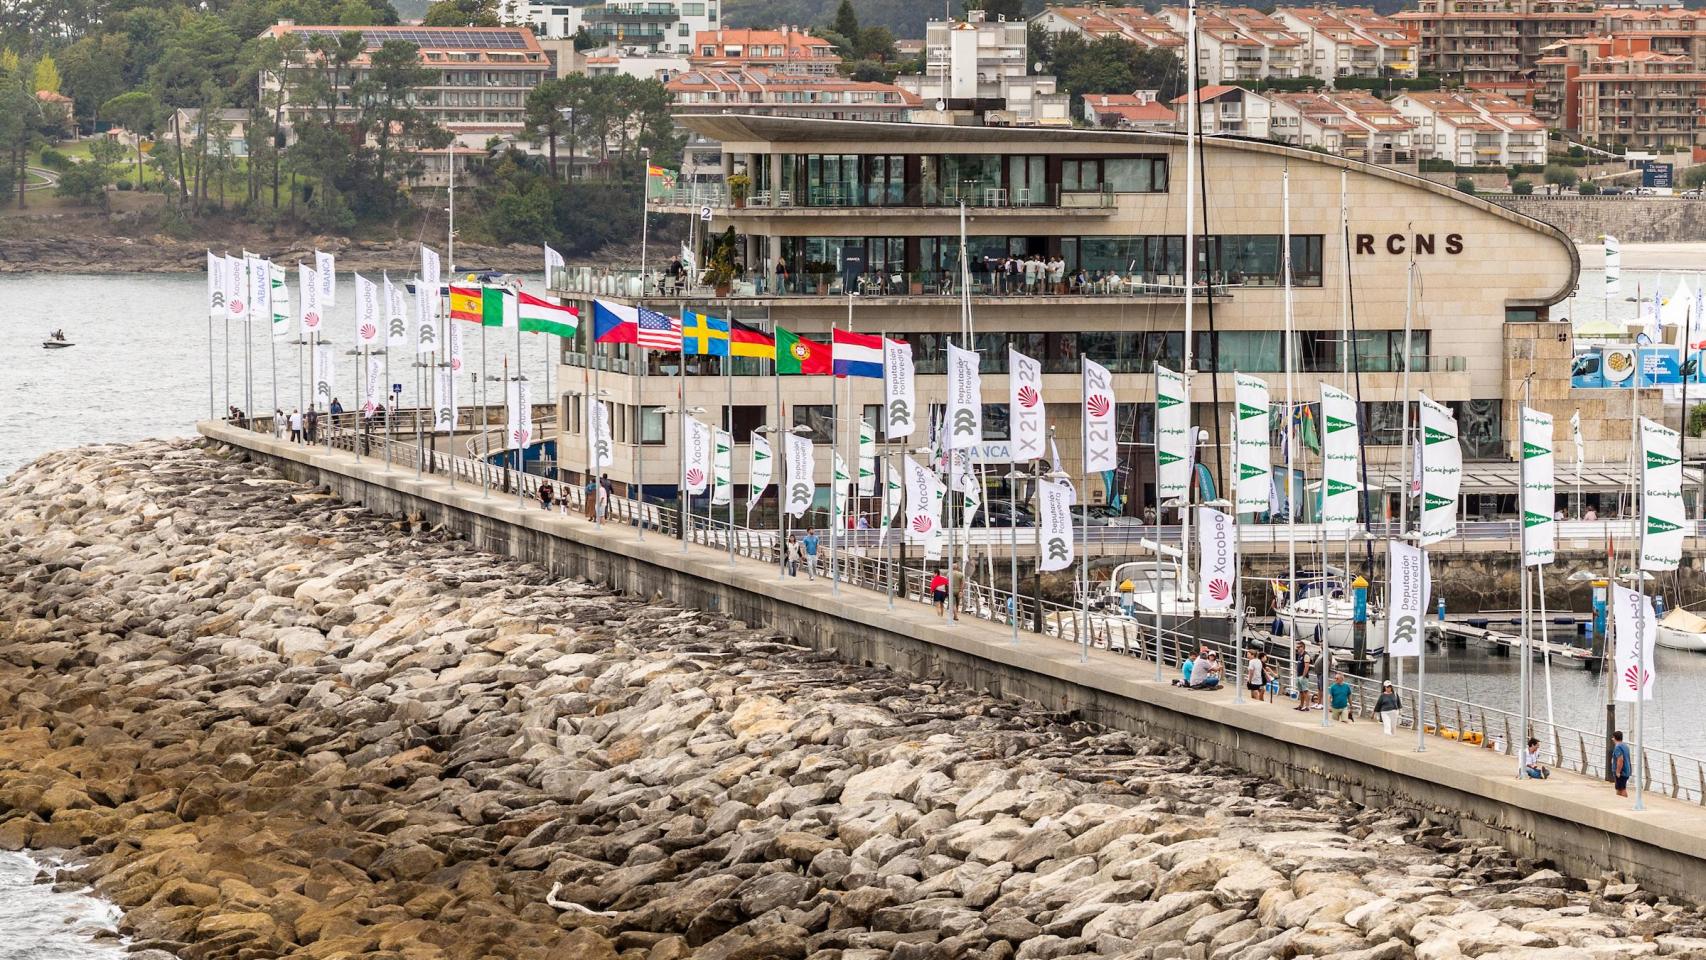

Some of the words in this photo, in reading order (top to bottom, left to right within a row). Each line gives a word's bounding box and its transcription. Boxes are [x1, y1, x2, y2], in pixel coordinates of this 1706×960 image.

[702, 207, 711, 219] 2
[1356, 233, 1464, 255] RCNS
[964, 361, 972, 405] Ponteve
[1213, 513, 1227, 574] Xacobeo
[1401, 555, 1411, 611] Deputación
[1410, 556, 1419, 611] Pontevedra
